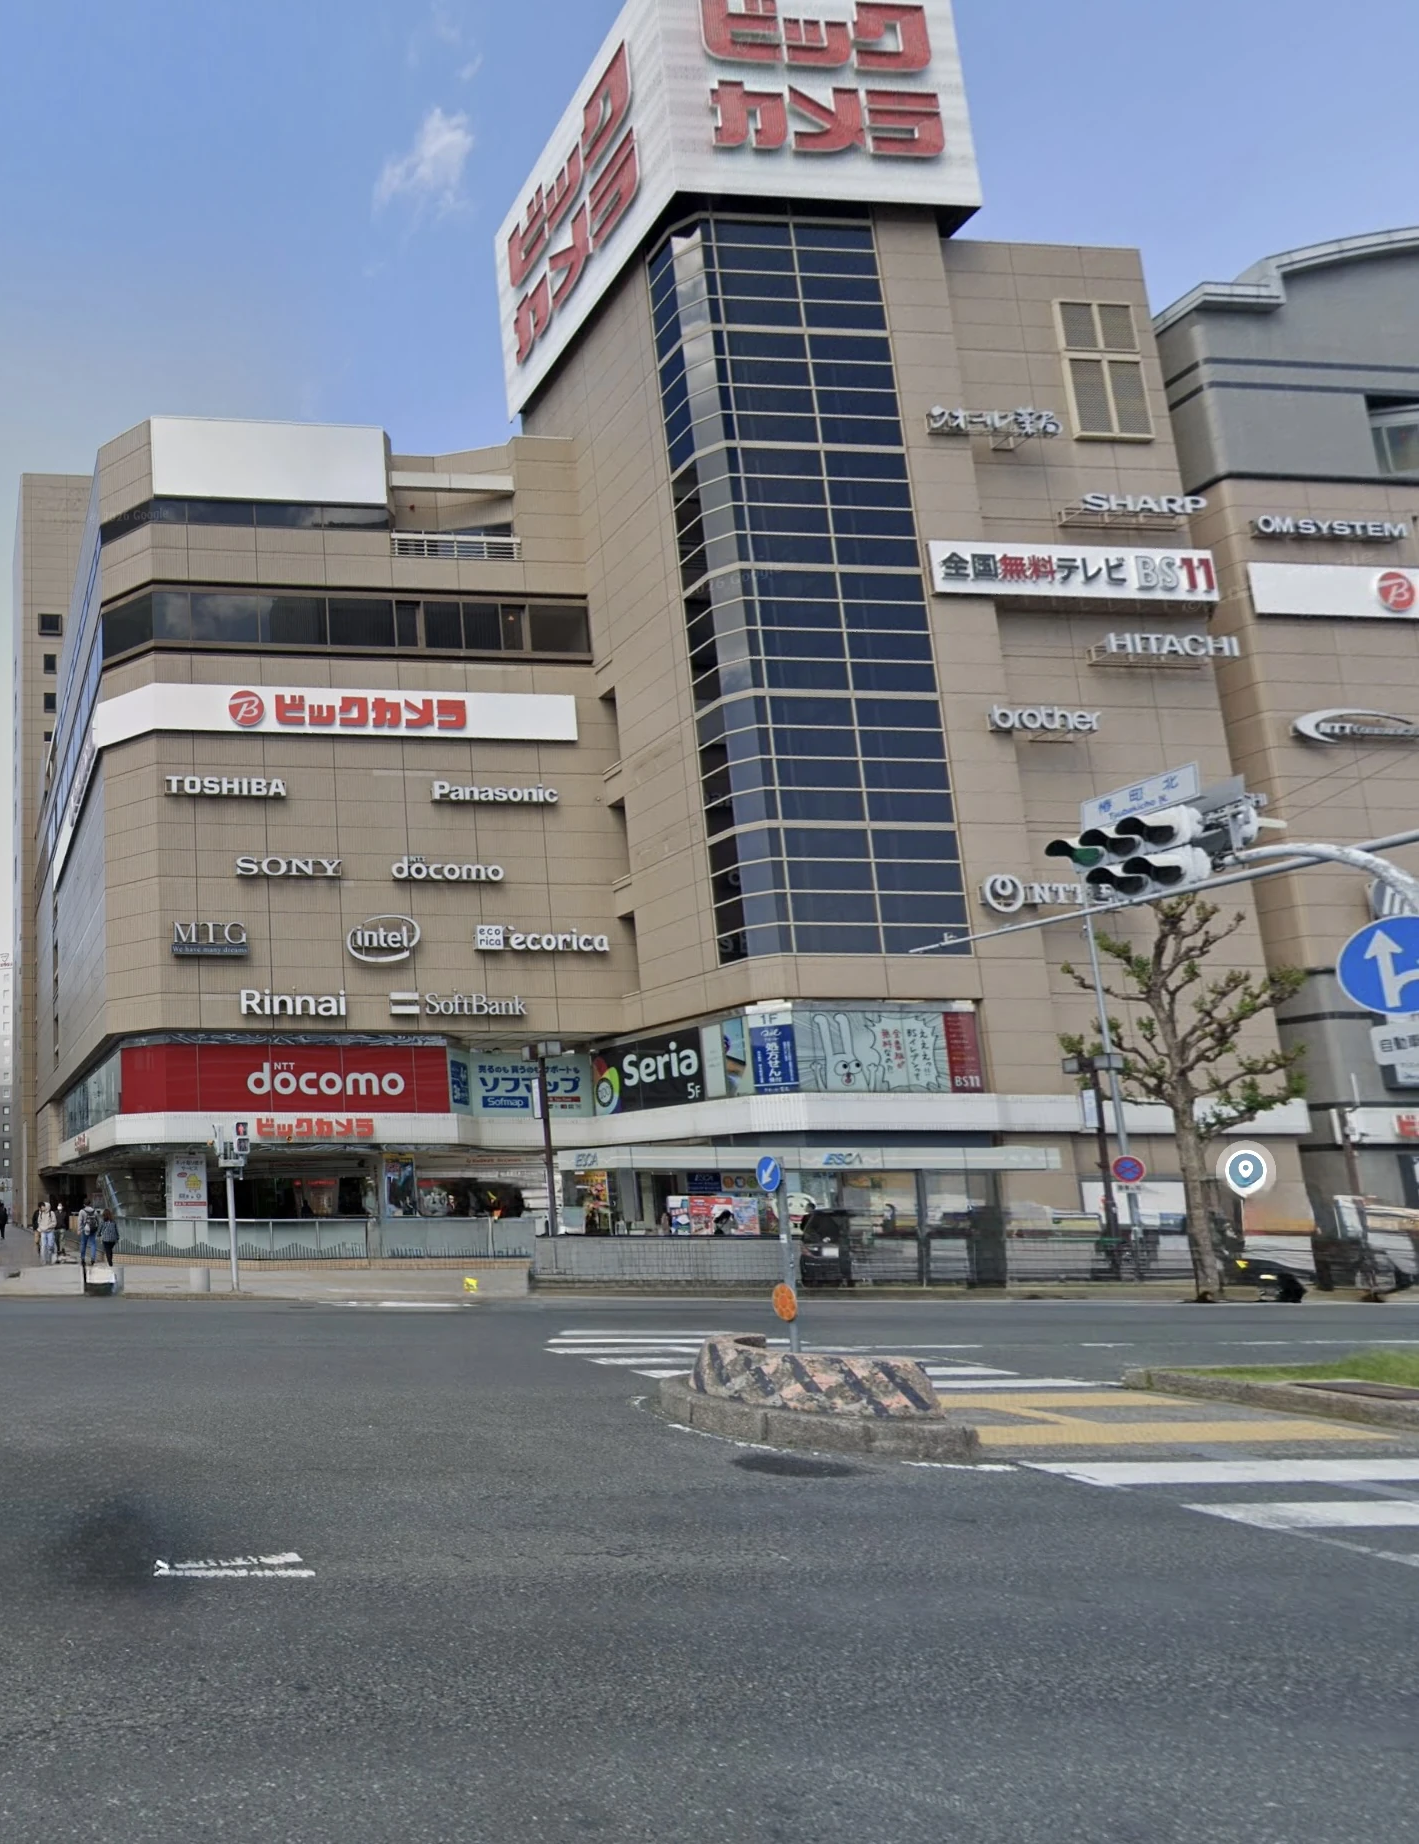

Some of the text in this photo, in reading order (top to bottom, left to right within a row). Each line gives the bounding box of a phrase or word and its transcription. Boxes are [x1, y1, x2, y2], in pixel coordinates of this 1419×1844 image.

[699, 0, 932, 71] ビック
[710, 80, 945, 157] カメラ
[508, 40, 631, 288] ビック
[514, 127, 642, 365] カメラ
[1082, 493, 1207, 515] SHARP
[1257, 515, 1409, 538] OM SYSTEM
[941, 552, 1127, 584] 全国無料テレビ
[1134, 556, 1216, 592] BS11
[1105, 632, 1240, 659] HITACHI
[275, 693, 467, 729] ビックカメラ
[991, 705, 1102, 732] brother
[165, 775, 287, 798] TOSHIBA
[433, 780, 559, 804] Panasonic
[235, 856, 343, 877] SONY
[391, 856, 505, 883] docomo
[173, 921, 247, 944] MTG
[354, 926, 410, 949] intel
[508, 926, 610, 953] ecorica
[240, 989, 347, 1016] Rinnai
[424, 992, 528, 1016] SoftBank
[274, 1062, 296, 1071] NTT
[622, 1041, 699, 1087] Seria
[247, 1062, 405, 1096] docomo
[687, 1082, 702, 1099] 5F
[954, 1076, 981, 1088] BS11
[487, 1097, 524, 1108] Sofmap
[256, 1117, 375, 1138] ビックカメラ
[575, 1152, 599, 1168] ESCA
[823, 1153, 863, 1166] ESCA
